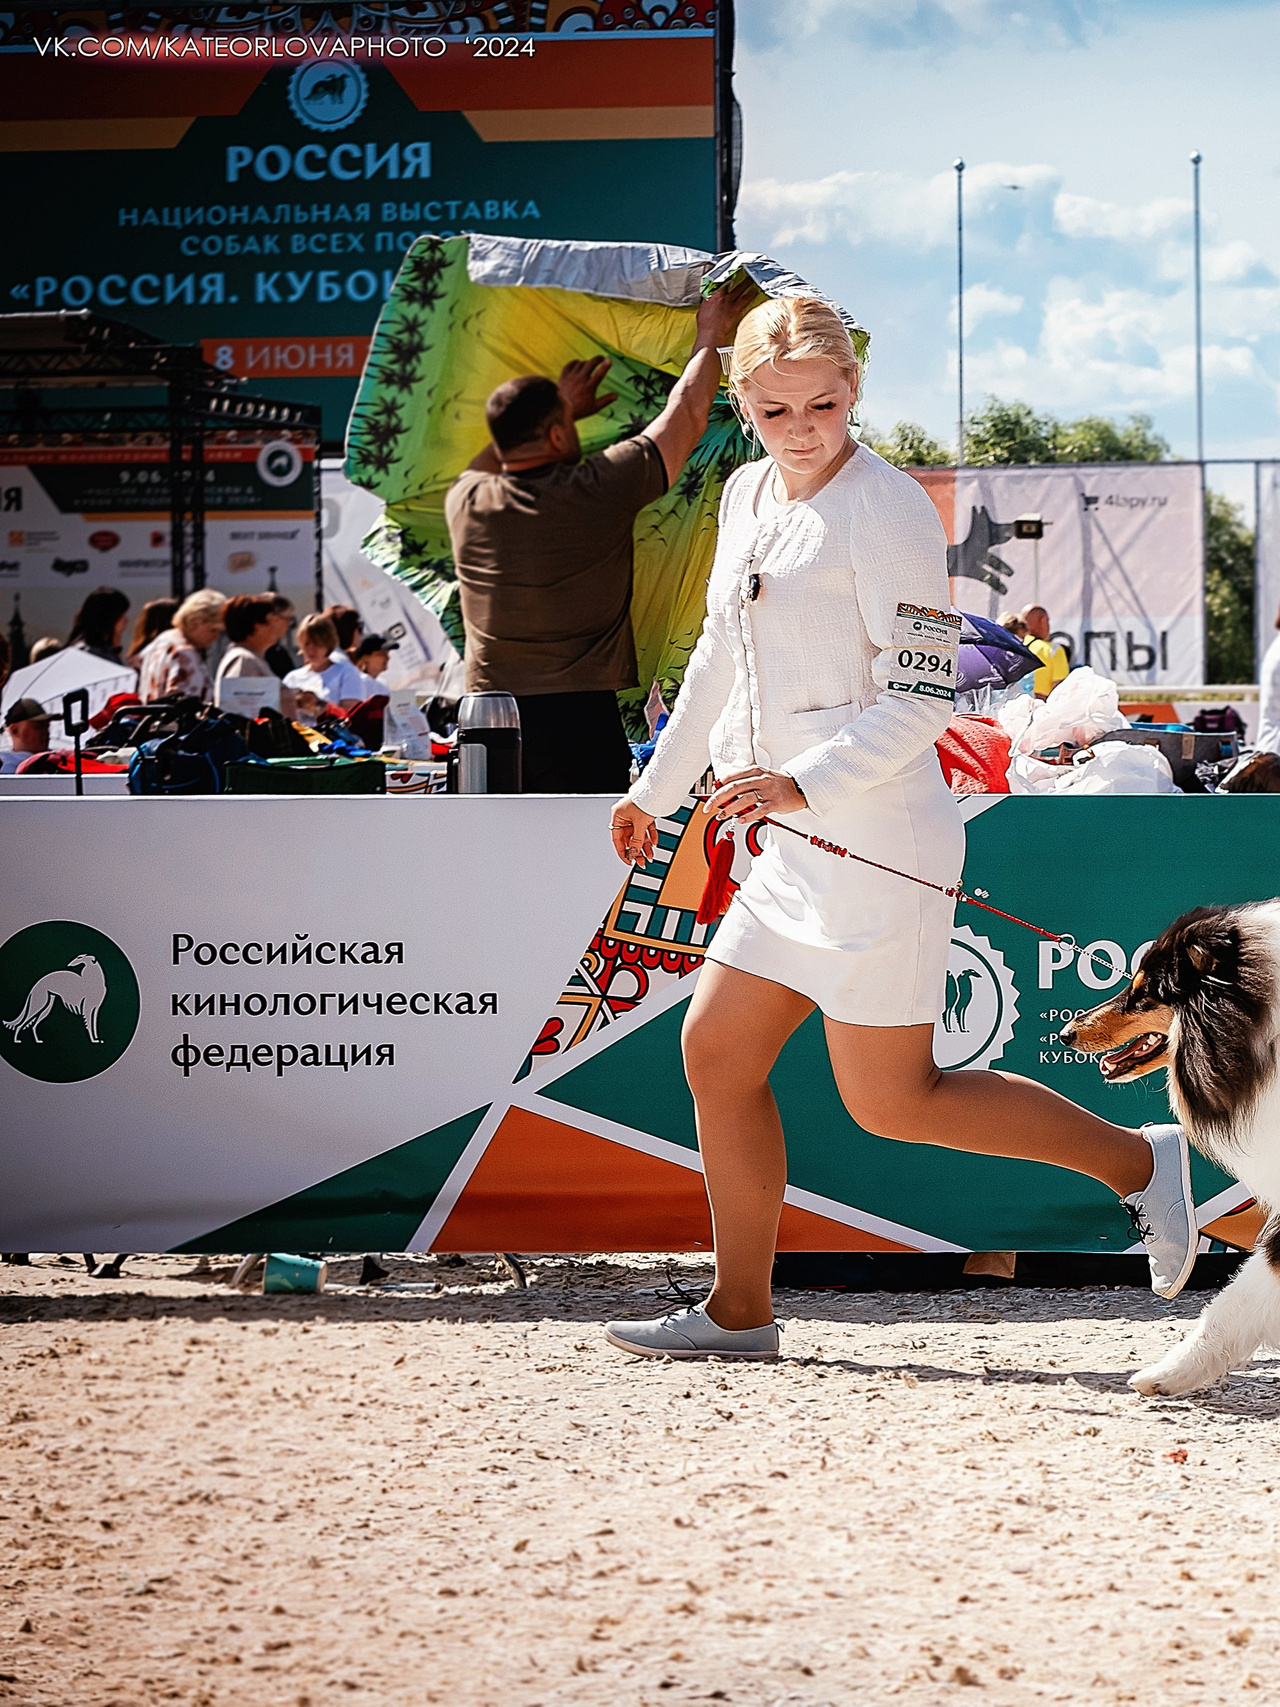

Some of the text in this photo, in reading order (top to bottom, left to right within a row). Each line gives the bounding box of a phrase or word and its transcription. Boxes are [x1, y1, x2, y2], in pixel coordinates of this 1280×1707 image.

[226, 141, 432, 183] РОССИЯ
[117, 200, 541, 230] НАЦИОНАЛЬНАЯ ВЫСТАВКА
[180, 234, 281, 257] СОБАК
[290, 232, 365, 255] ВСЕХ
[10, 271, 240, 308] «РОССИЯ.
[215, 342, 355, 371] 8 ИЮНЯ
[897, 648, 953, 678] 0294
[918, 684, 952, 699] 8.06.2024
[171, 933, 405, 966] Российская
[171, 991, 499, 1017] кинологическая
[171, 1033, 396, 1077] федерация
[1039, 1050, 1100, 1064] КУБОК
